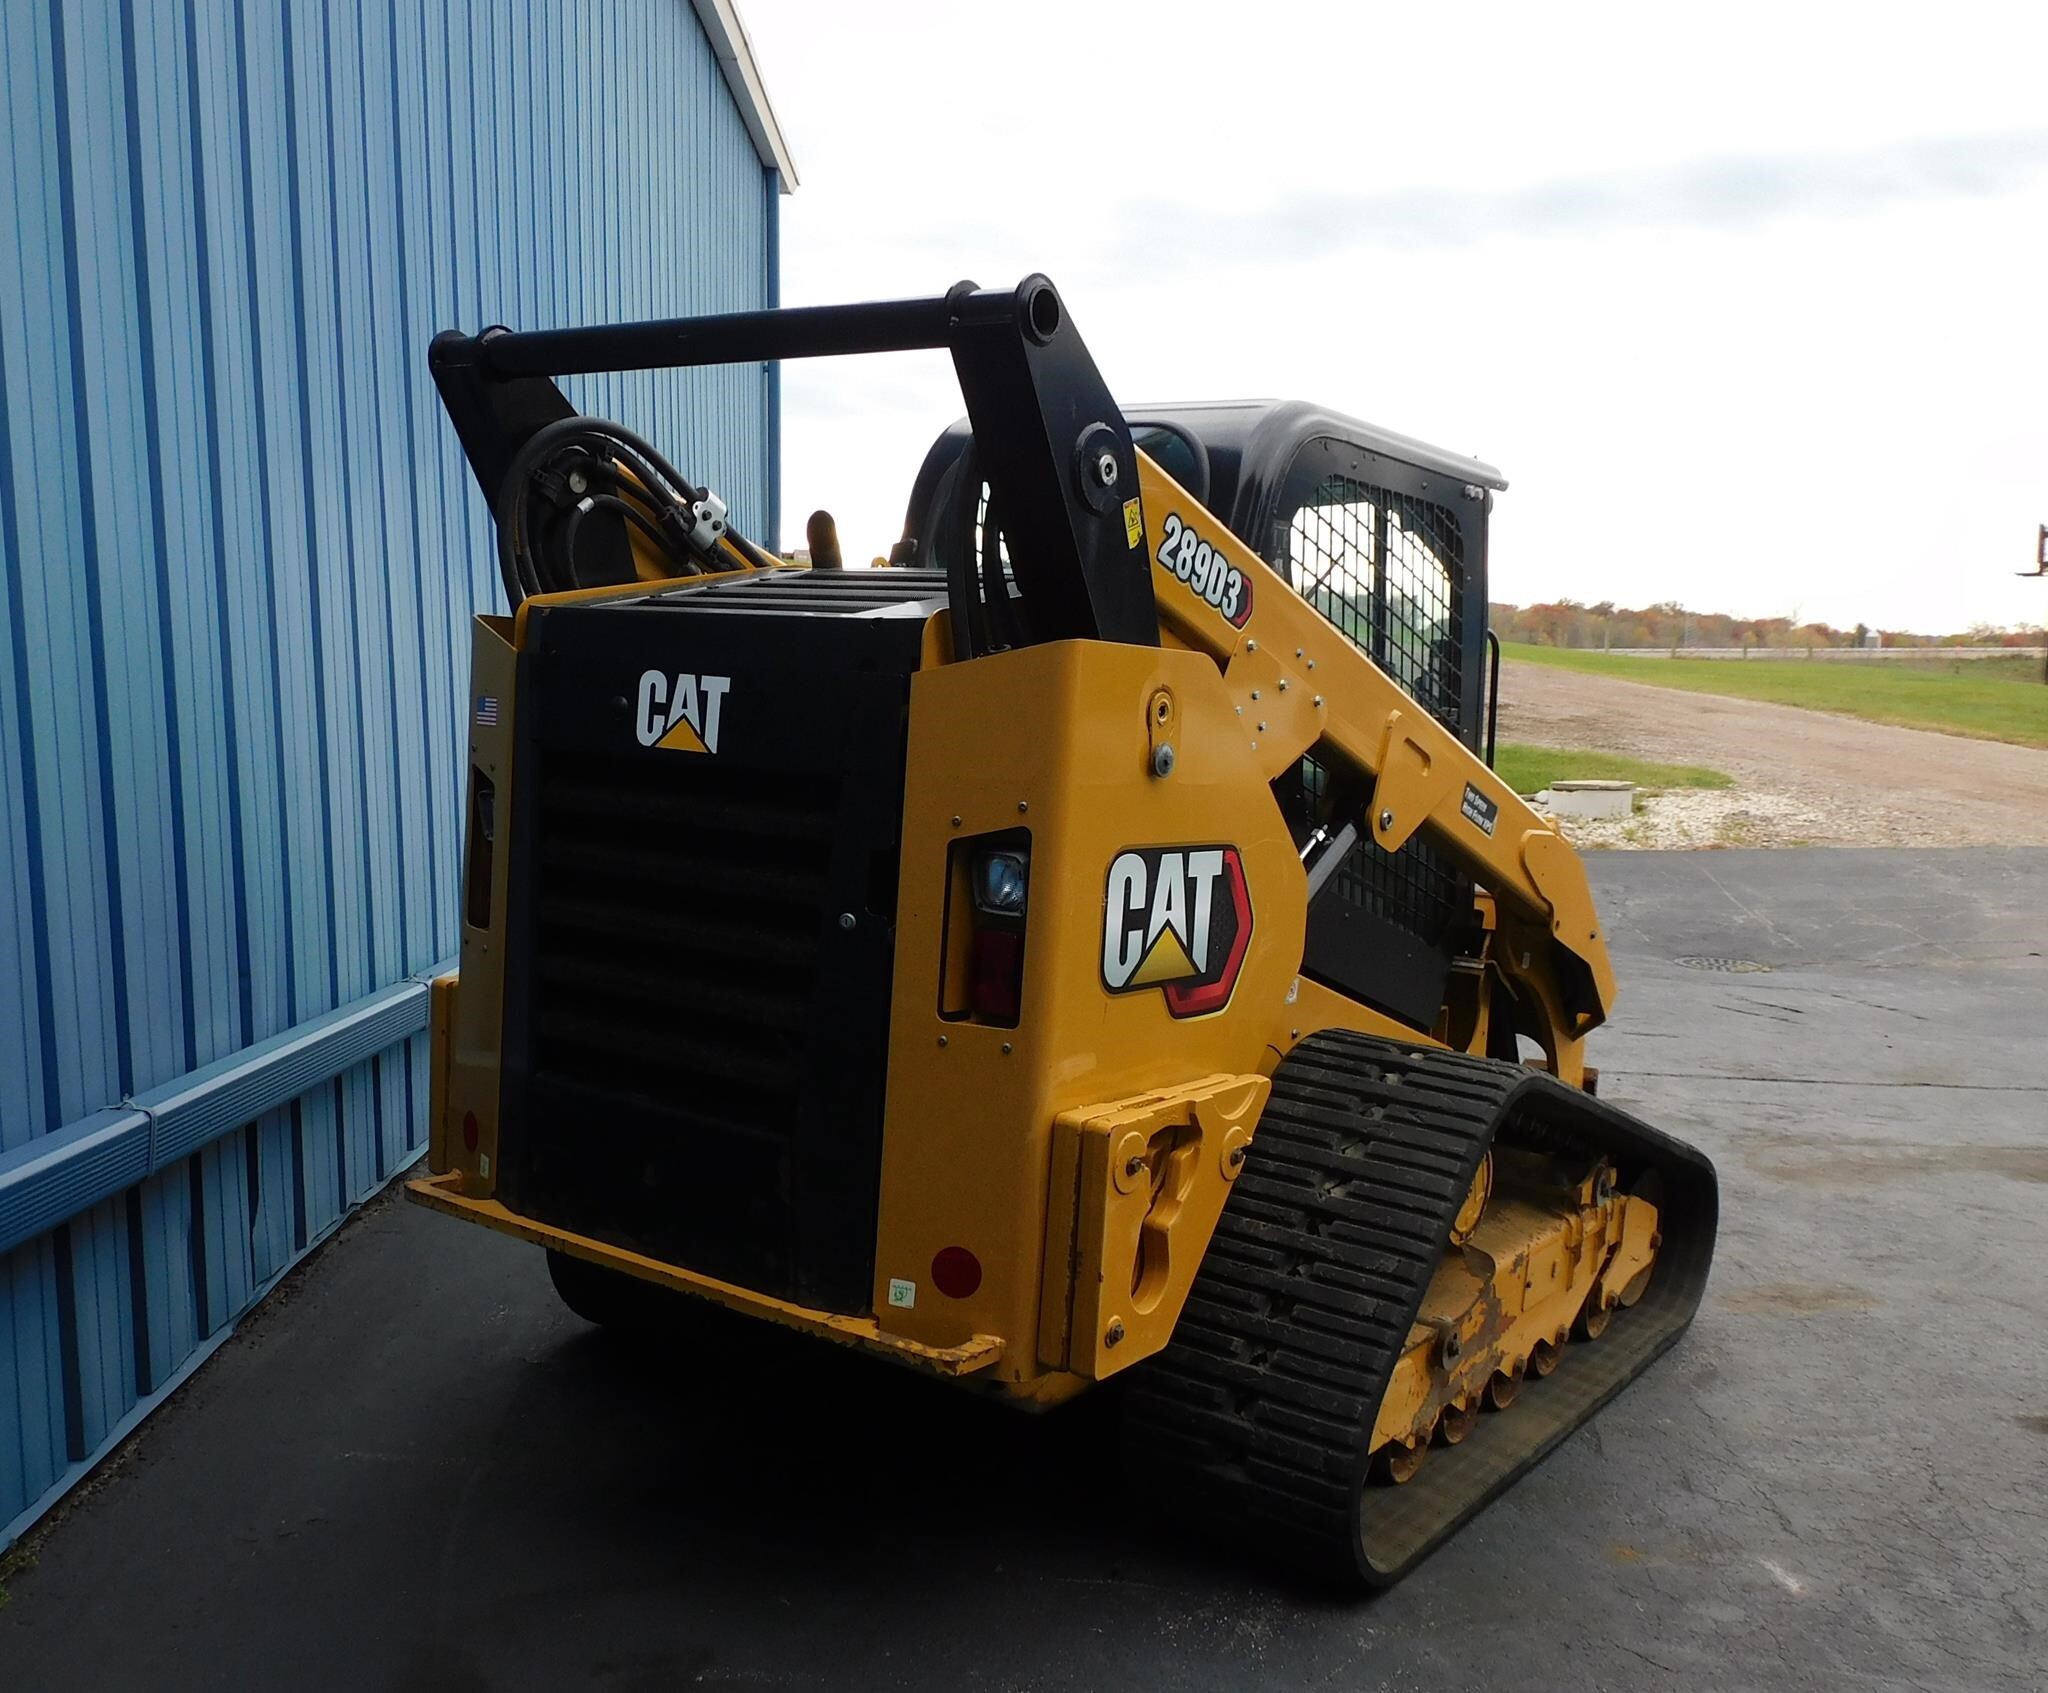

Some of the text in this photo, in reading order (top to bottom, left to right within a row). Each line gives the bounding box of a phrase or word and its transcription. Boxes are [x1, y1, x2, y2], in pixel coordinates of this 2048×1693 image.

[1158, 515, 1242, 618] 289D3
[636, 669, 731, 754] CAT
[1103, 850, 1224, 988] CAT
